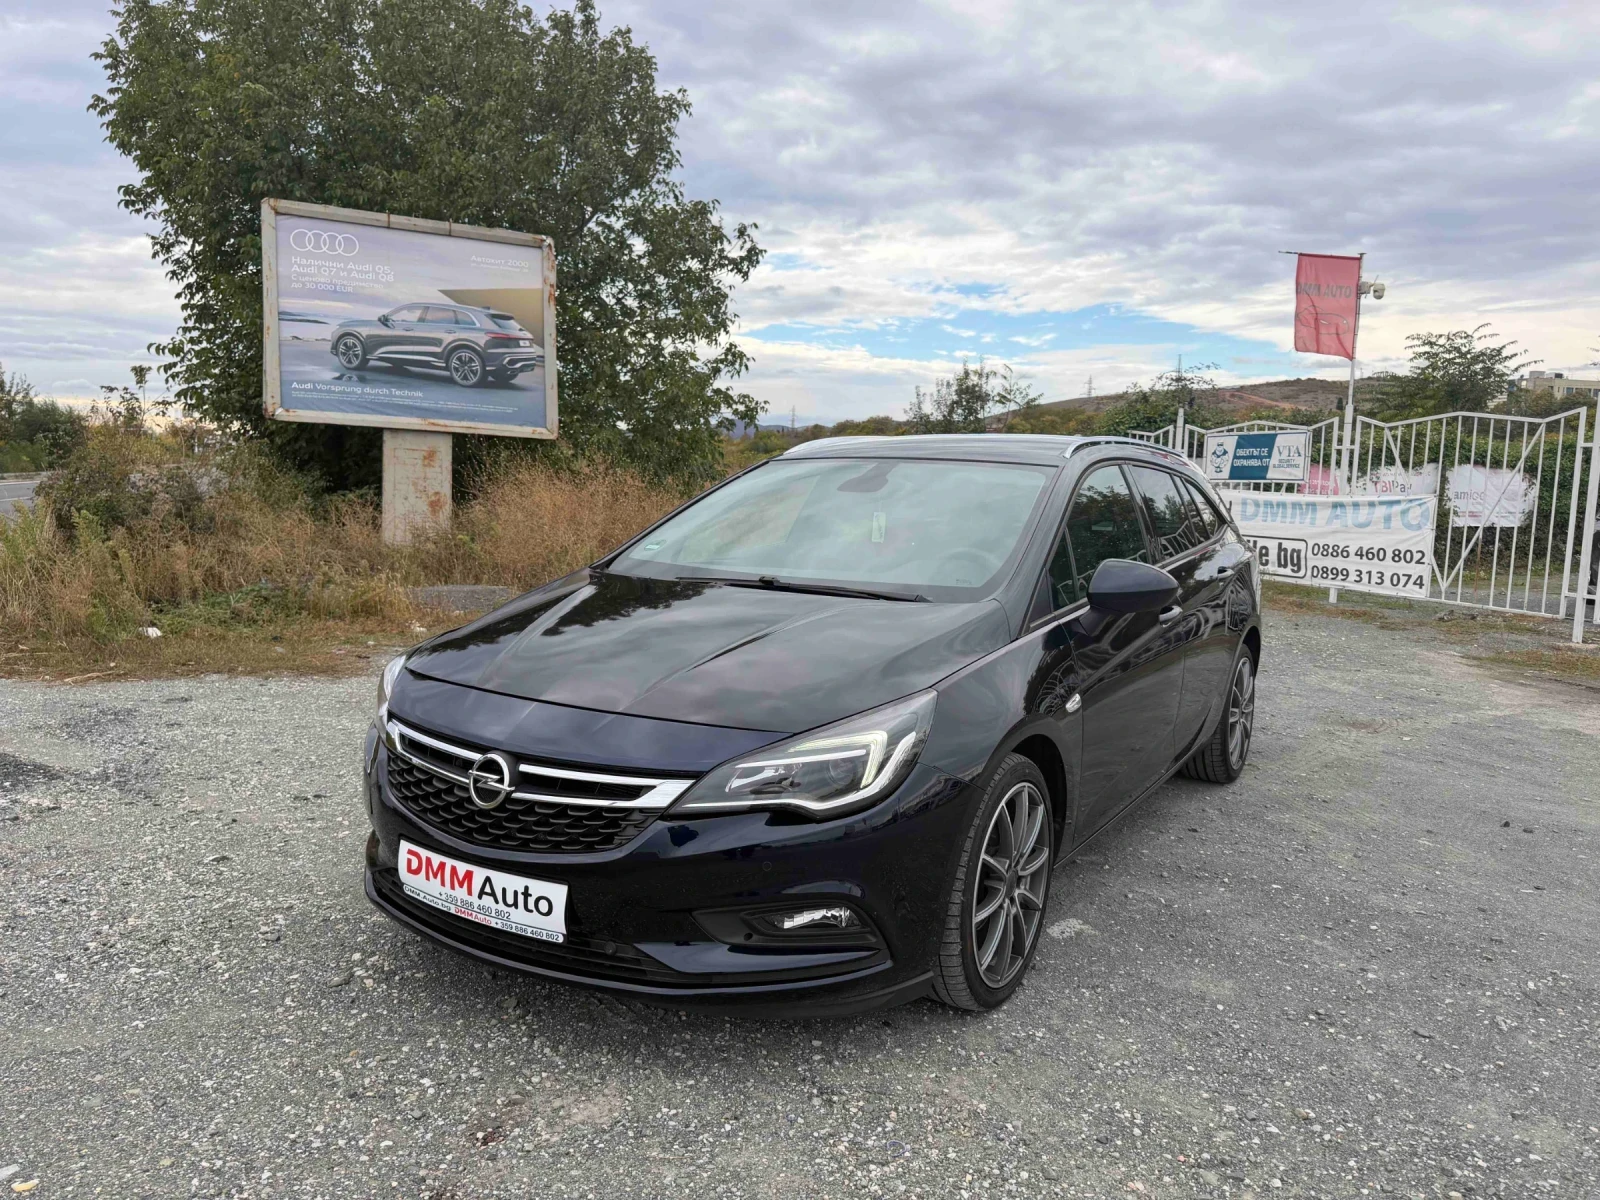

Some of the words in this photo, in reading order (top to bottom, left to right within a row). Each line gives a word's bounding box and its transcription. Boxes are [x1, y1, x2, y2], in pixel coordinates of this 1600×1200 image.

[291, 256, 344, 269] Налични
[347, 262, 372, 272] Audi
[375, 265, 394, 275] Q5,
[507, 259, 529, 268] 2000
[291, 264, 318, 274] Audi
[321, 267, 337, 276] Q7
[350, 271, 376, 280] Audi
[378, 273, 394, 282] Q8
[317, 283, 335, 291] 000
[336, 285, 354, 293] EUR
[1323, 284, 1352, 299] AUTO
[291, 381, 314, 390] Audi
[315, 383, 362, 394] Vorsprung
[363, 386, 389, 395] durch
[391, 388, 424, 398] Technik
[1260, 448, 1269, 456] СЕ
[1276, 445, 1302, 458] VTA
[1233, 458, 1261, 467] ОХРАНЯВА
[1262, 458, 1270, 466] ОТ
[1240, 497, 1318, 528] DMM
[1326, 499, 1430, 531] AUTO
[1311, 542, 1350, 559] 0886
[1354, 545, 1387, 562] 460
[1391, 548, 1426, 565] 802
[1311, 565, 1350, 581] 0899
[1354, 569, 1385, 585] 313
[1390, 572, 1425, 590] 074
[444, 892, 458, 905] 359
[460, 897, 475, 910] 886
[477, 903, 493, 915] 460
[495, 908, 511, 920] 802
[500, 921, 513, 931] 359
[514, 925, 528, 935] 886
[530, 929, 544, 939] 460
[545, 932, 560, 942] 802
